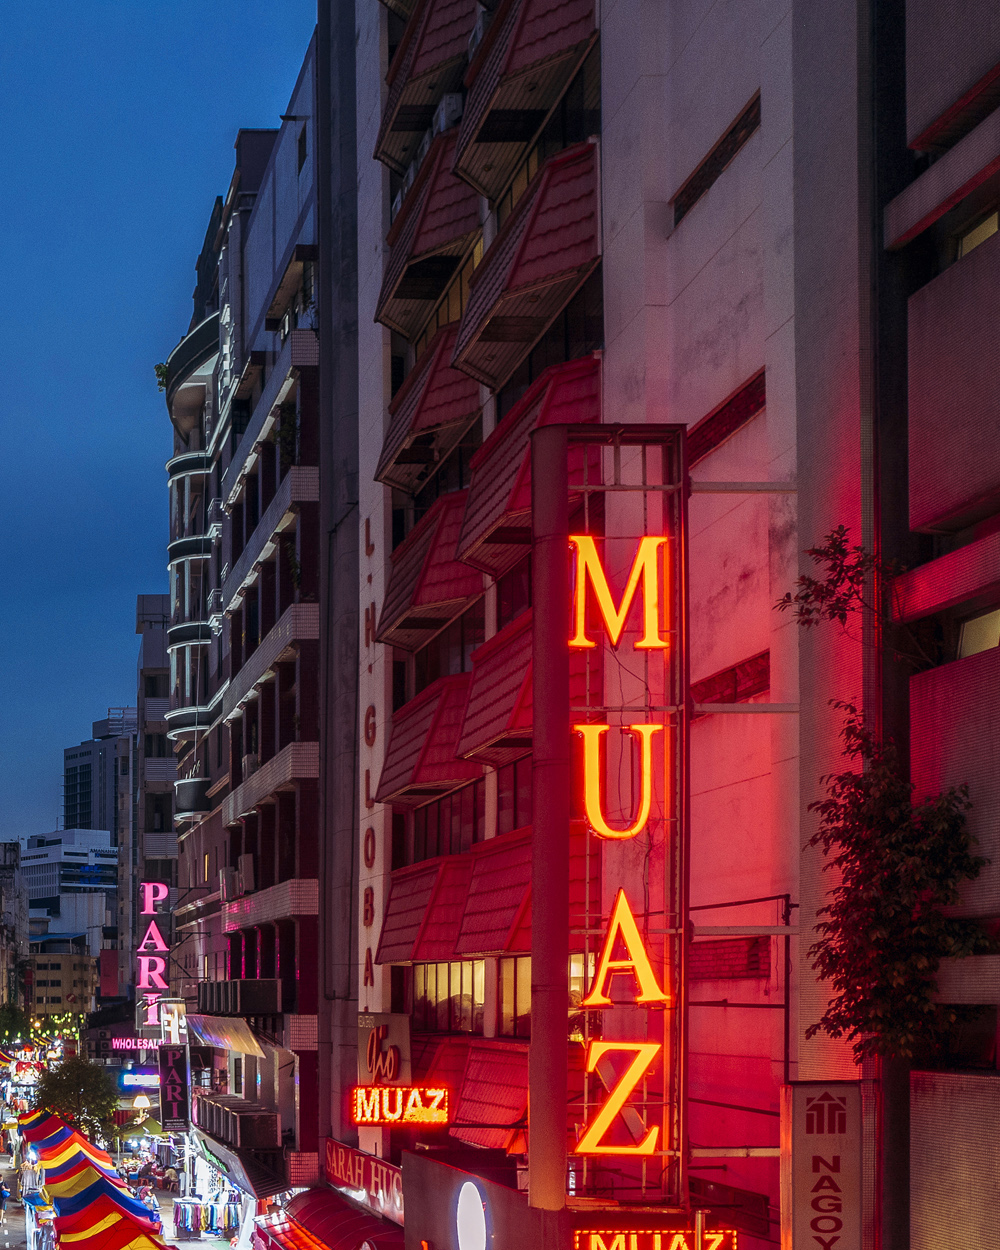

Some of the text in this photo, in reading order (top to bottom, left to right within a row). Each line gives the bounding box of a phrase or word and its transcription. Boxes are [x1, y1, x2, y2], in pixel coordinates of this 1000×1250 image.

[568, 535, 672, 1154] MUAZ
[136, 882, 170, 1026] PARI
[164, 1050, 184, 1119] PARI
[355, 1087, 446, 1122] MUAZ
[326, 1141, 365, 1189] SARAH
